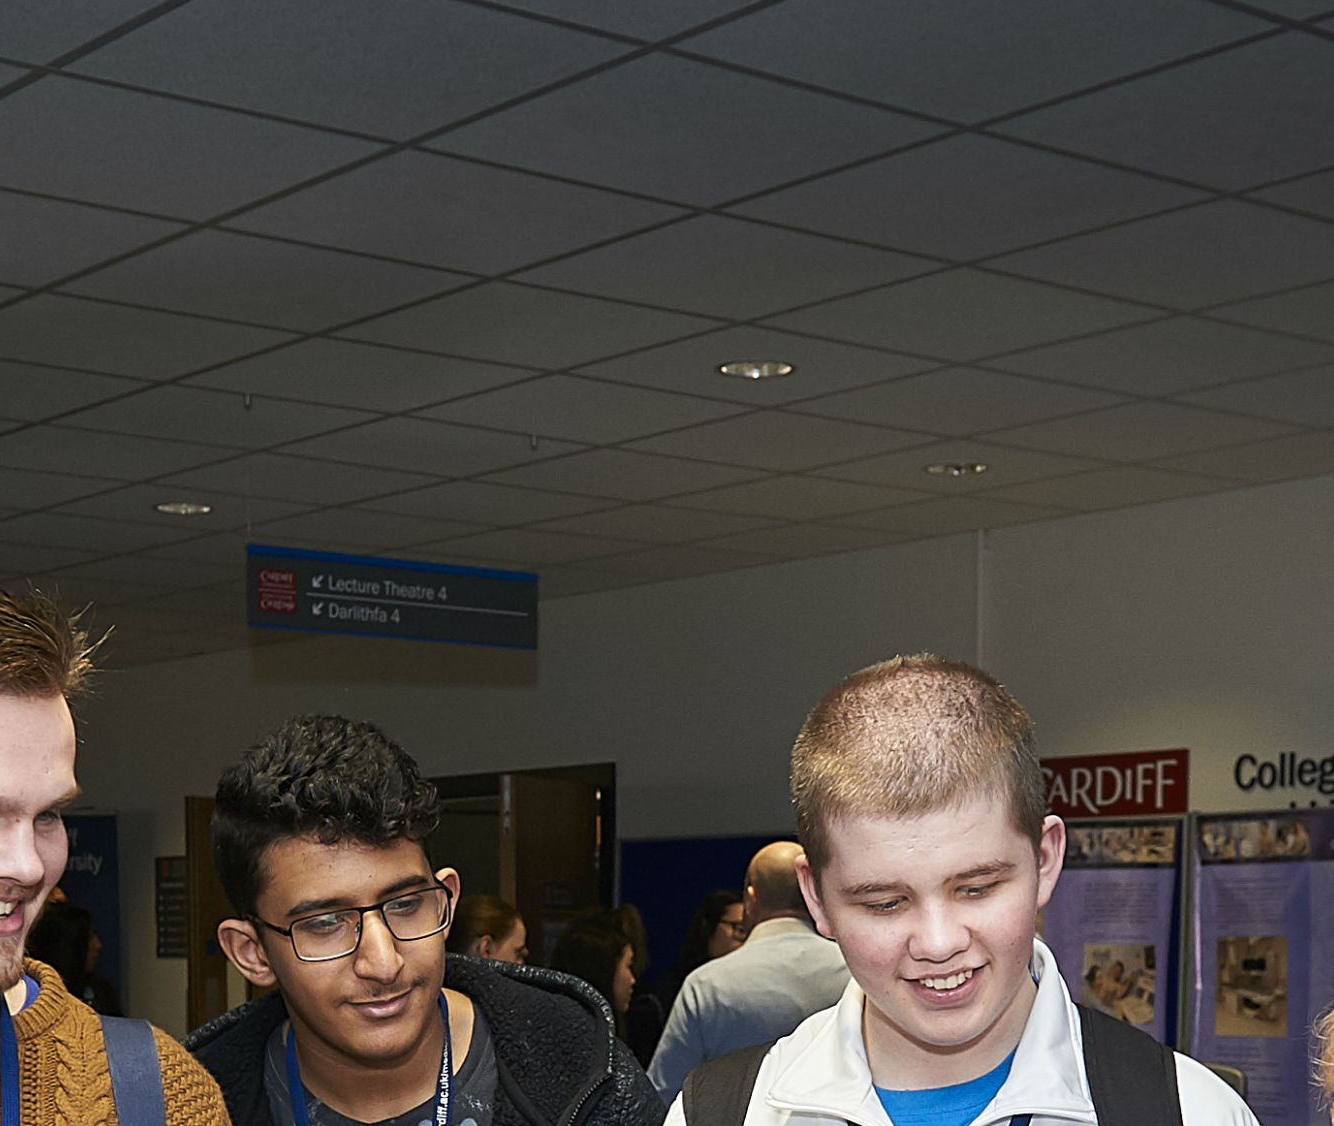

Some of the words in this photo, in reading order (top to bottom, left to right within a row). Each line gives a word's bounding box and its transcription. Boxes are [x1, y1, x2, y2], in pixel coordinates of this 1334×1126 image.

[328, 575, 380, 595] Lecture
[383, 580, 435, 601] Theatre
[438, 586, 448, 601] 4
[328, 602, 388, 623] Darlithfa
[391, 608, 401, 623] 4
